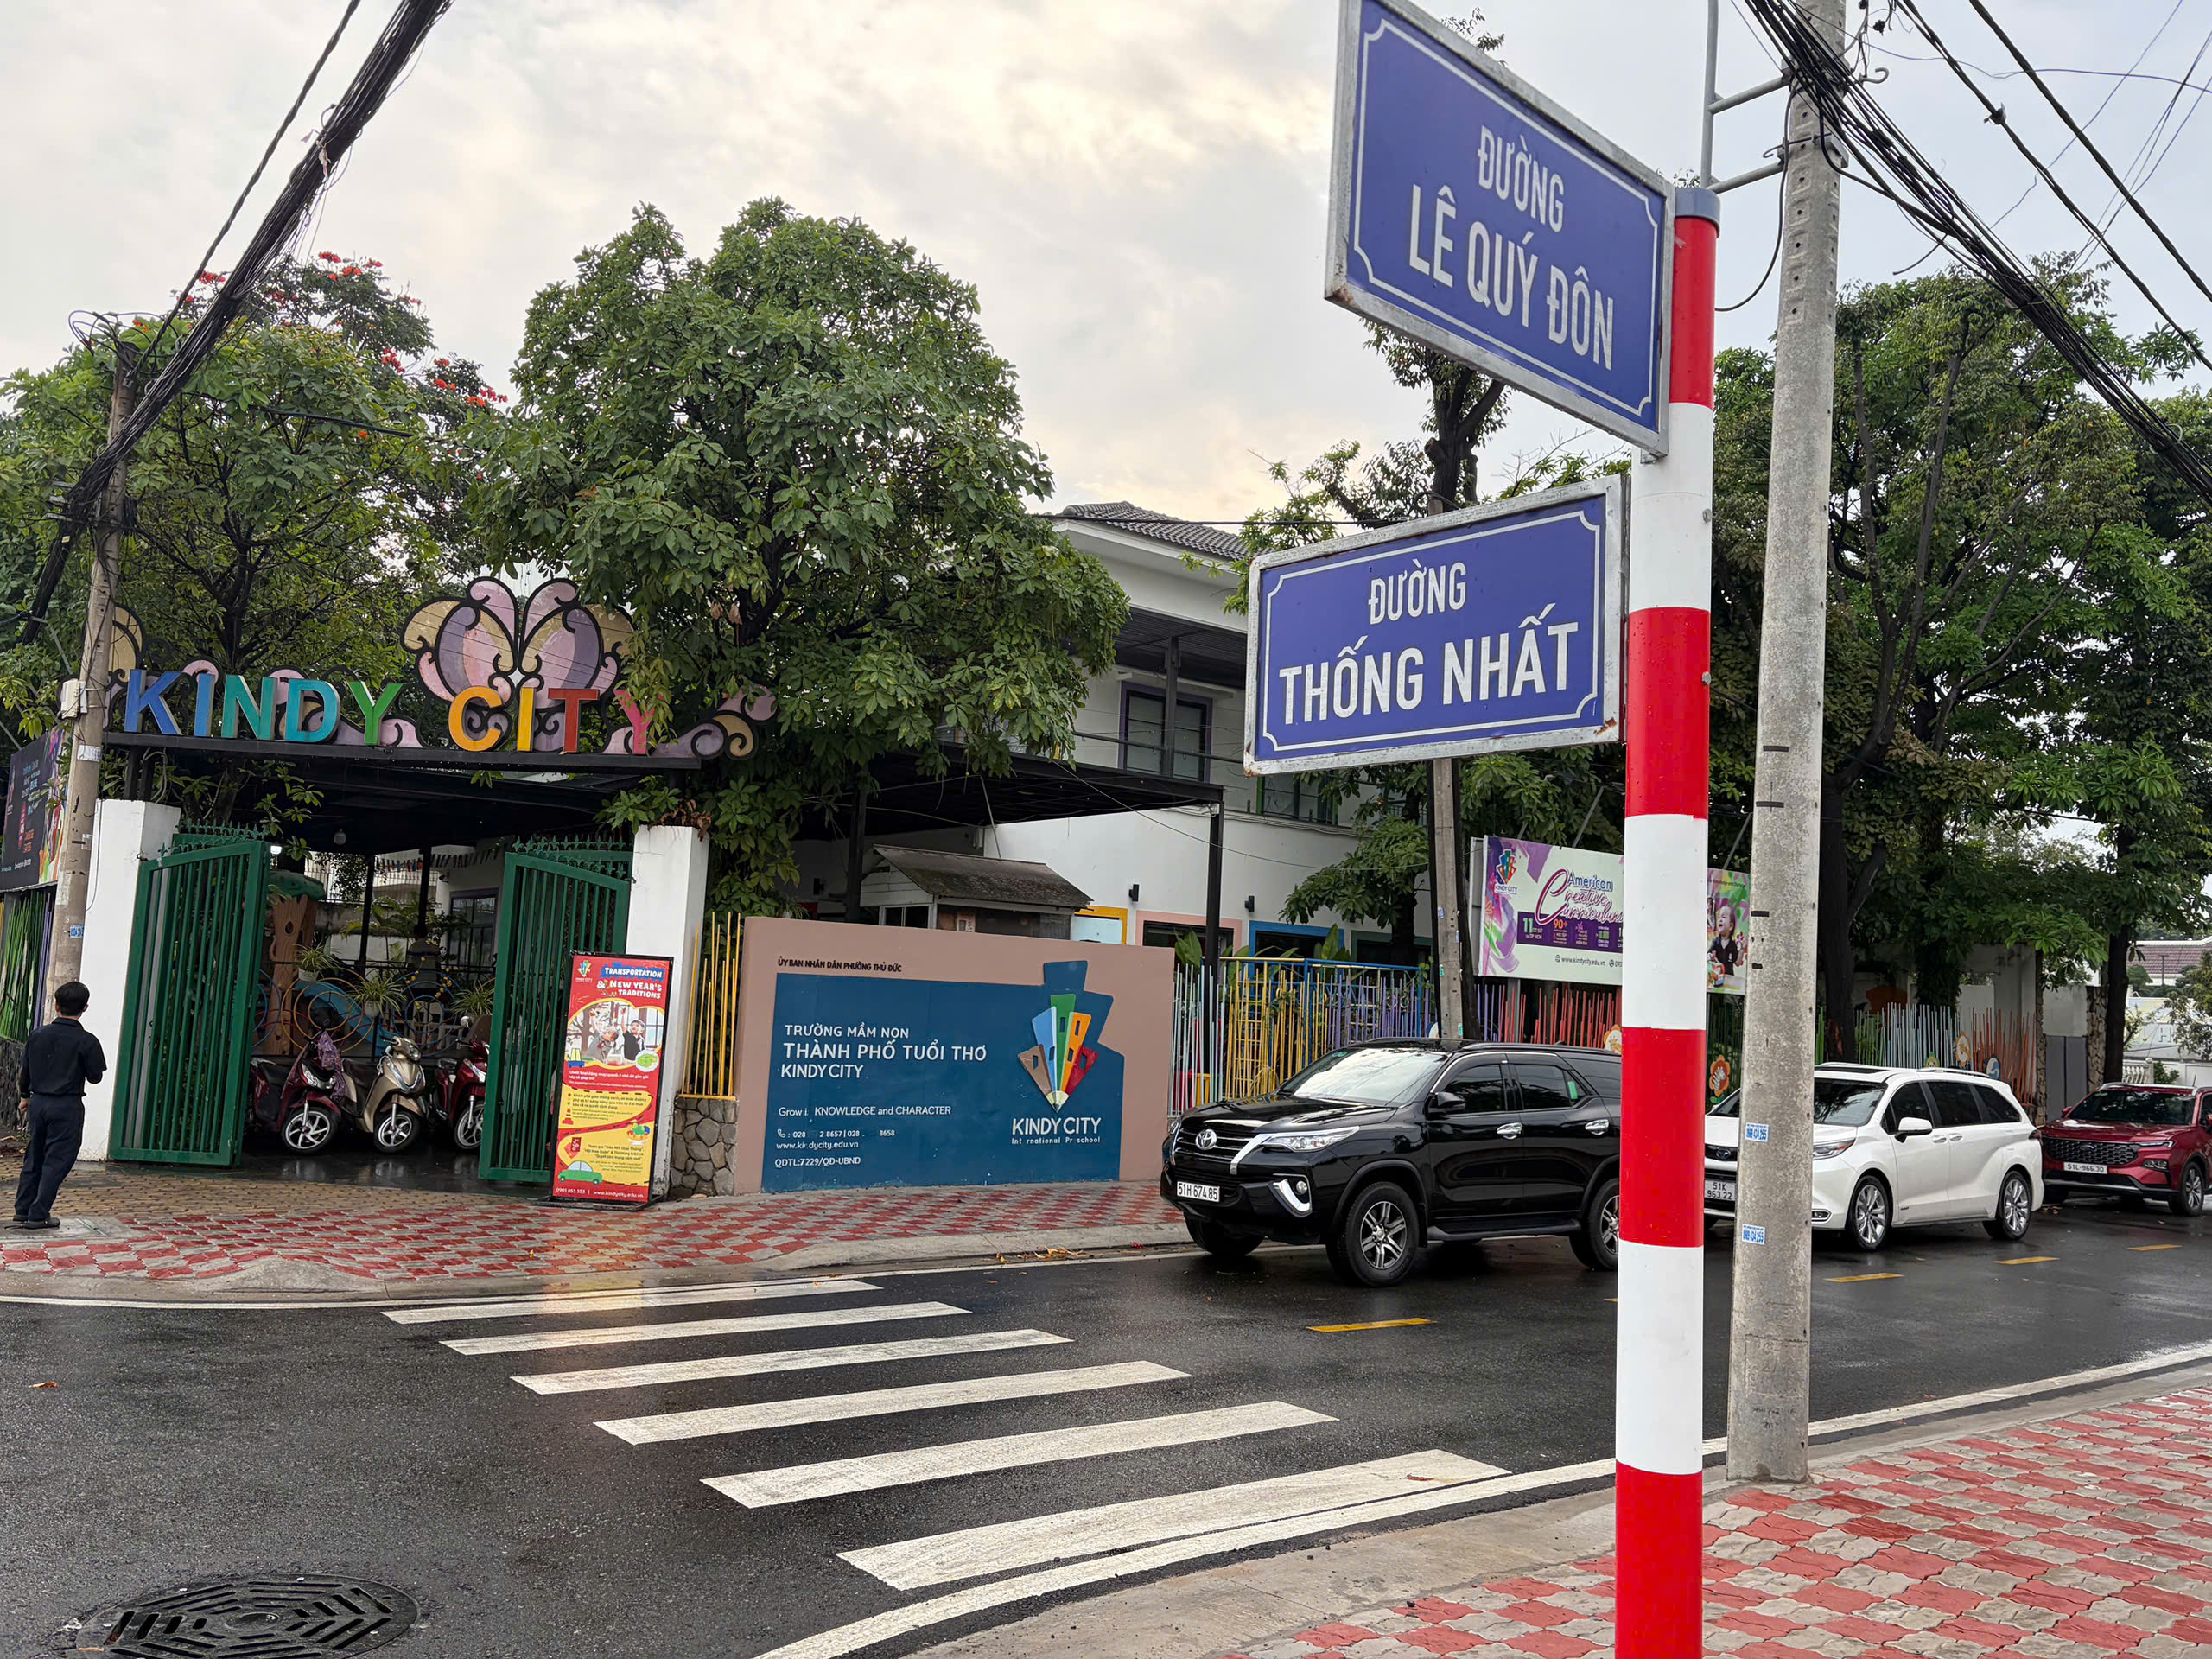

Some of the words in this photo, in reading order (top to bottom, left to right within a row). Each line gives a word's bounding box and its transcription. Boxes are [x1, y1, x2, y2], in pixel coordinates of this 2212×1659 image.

[1478, 125, 1565, 232] ĐƯỜNG
[1408, 184, 1457, 288] LÊ
[1467, 231, 1538, 328] QUÝ
[1547, 265, 1614, 371] ĐÔN
[1368, 559, 1466, 625] ĐƯỜNG
[1279, 635, 1424, 726] THỐNG
[1442, 603, 1579, 705] NHẤT
[124, 668, 404, 745] KINDY
[448, 686, 657, 755] CITY
[1568, 872, 1612, 890] American
[1523, 918, 1534, 933] 11
[1554, 919, 1568, 929] 90+
[604, 967, 663, 978] TRANSPORTATION
[789, 958, 804, 968] BAN
[804, 959, 826, 969] NHÂN
[827, 960, 842, 969] DÂN
[843, 961, 872, 971] PHƯỜNG
[874, 962, 887, 972] THỦ
[887, 963, 902, 973] ĐỨC
[597, 980, 606, 989] &
[609, 980, 632, 989] NEW
[633, 982, 663, 992] YEAR'S
[618, 989, 661, 1000] TRADITIONS
[785, 1022, 843, 1038] TRƯỜNG
[847, 1021, 876, 1038] MẦM
[880, 1027, 910, 1039] NON
[783, 1039, 850, 1059] THÀNH
[857, 1039, 896, 1060] PHỐ
[902, 1039, 945, 1060] TUỔI
[951, 1045, 988, 1062] THƠ
[780, 1064, 827, 1079] KINDY
[828, 1064, 864, 1078] CITY
[779, 1107, 803, 1116] Grow
[814, 1106, 876, 1116] KNOWLEDGE
[877, 1106, 893, 1116] and
[895, 1106, 951, 1116] CHARACTER
[1012, 1117, 1062, 1135] KINDY
[1063, 1116, 1102, 1135] CITY
[1713, 1182, 1726, 1191] 51K
[1707, 1190, 1732, 1199] 963.22
